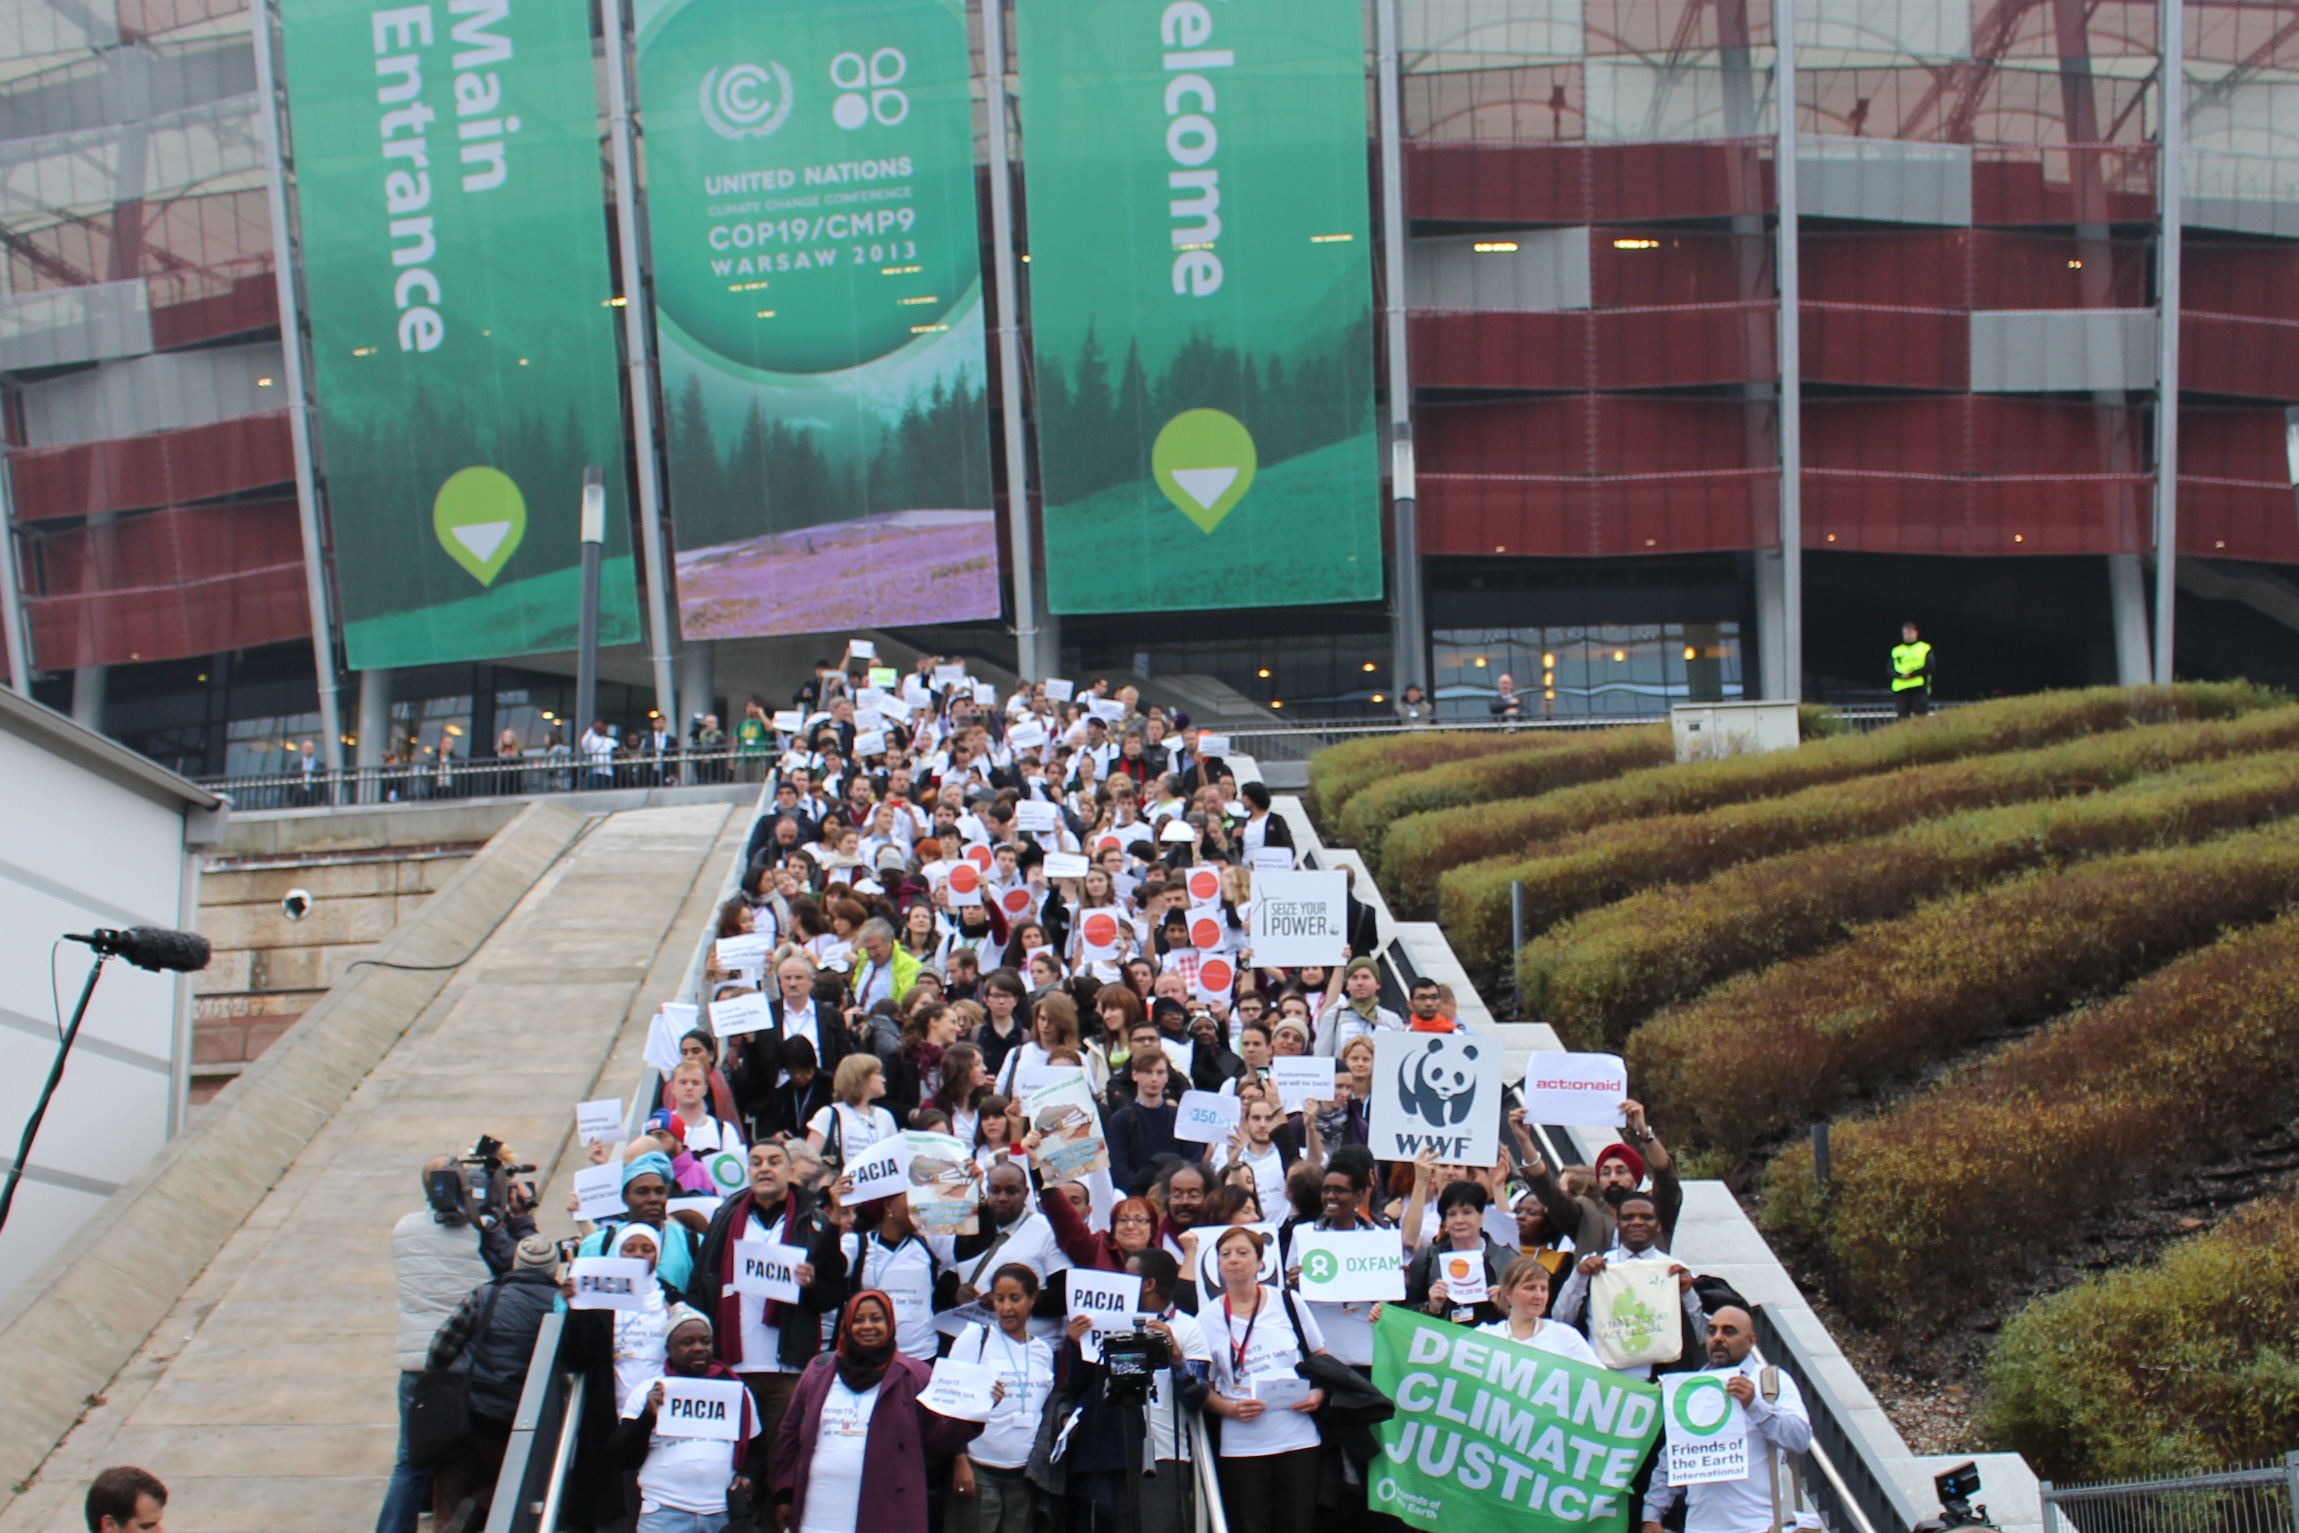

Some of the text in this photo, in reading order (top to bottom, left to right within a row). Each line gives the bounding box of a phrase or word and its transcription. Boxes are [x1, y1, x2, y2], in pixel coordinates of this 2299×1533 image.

[447, 0, 521, 192] Main
[1160, 0, 1235, 297] elcome
[372, 4, 445, 352] Entrance
[704, 156, 914, 196] UNITED NATIONS
[706, 186, 914, 217] CLIMATE CHANGE CONFERENCE
[708, 207, 915, 250] COP19/CMP9
[710, 240, 917, 277] WARSAW 2013
[1271, 902, 1327, 916] SEIZE YOUR
[1271, 916, 1327, 936] POWER
[1395, 1133, 1472, 1159] WWF
[746, 1258, 791, 1283] PACJA
[1346, 1255, 1400, 1272] OXFAM
[1073, 1289, 1124, 1312] PACJA
[1408, 1326, 1657, 1438] DEMAND
[671, 1398, 726, 1420] PACJA
[1396, 1372, 1640, 1488] CLIMATE
[1671, 1438, 1744, 1456] Friends of
[1385, 1422, 1618, 1522] JUSTICE
[1672, 1453, 1744, 1470] the Earth
[1672, 1466, 1745, 1481] International
